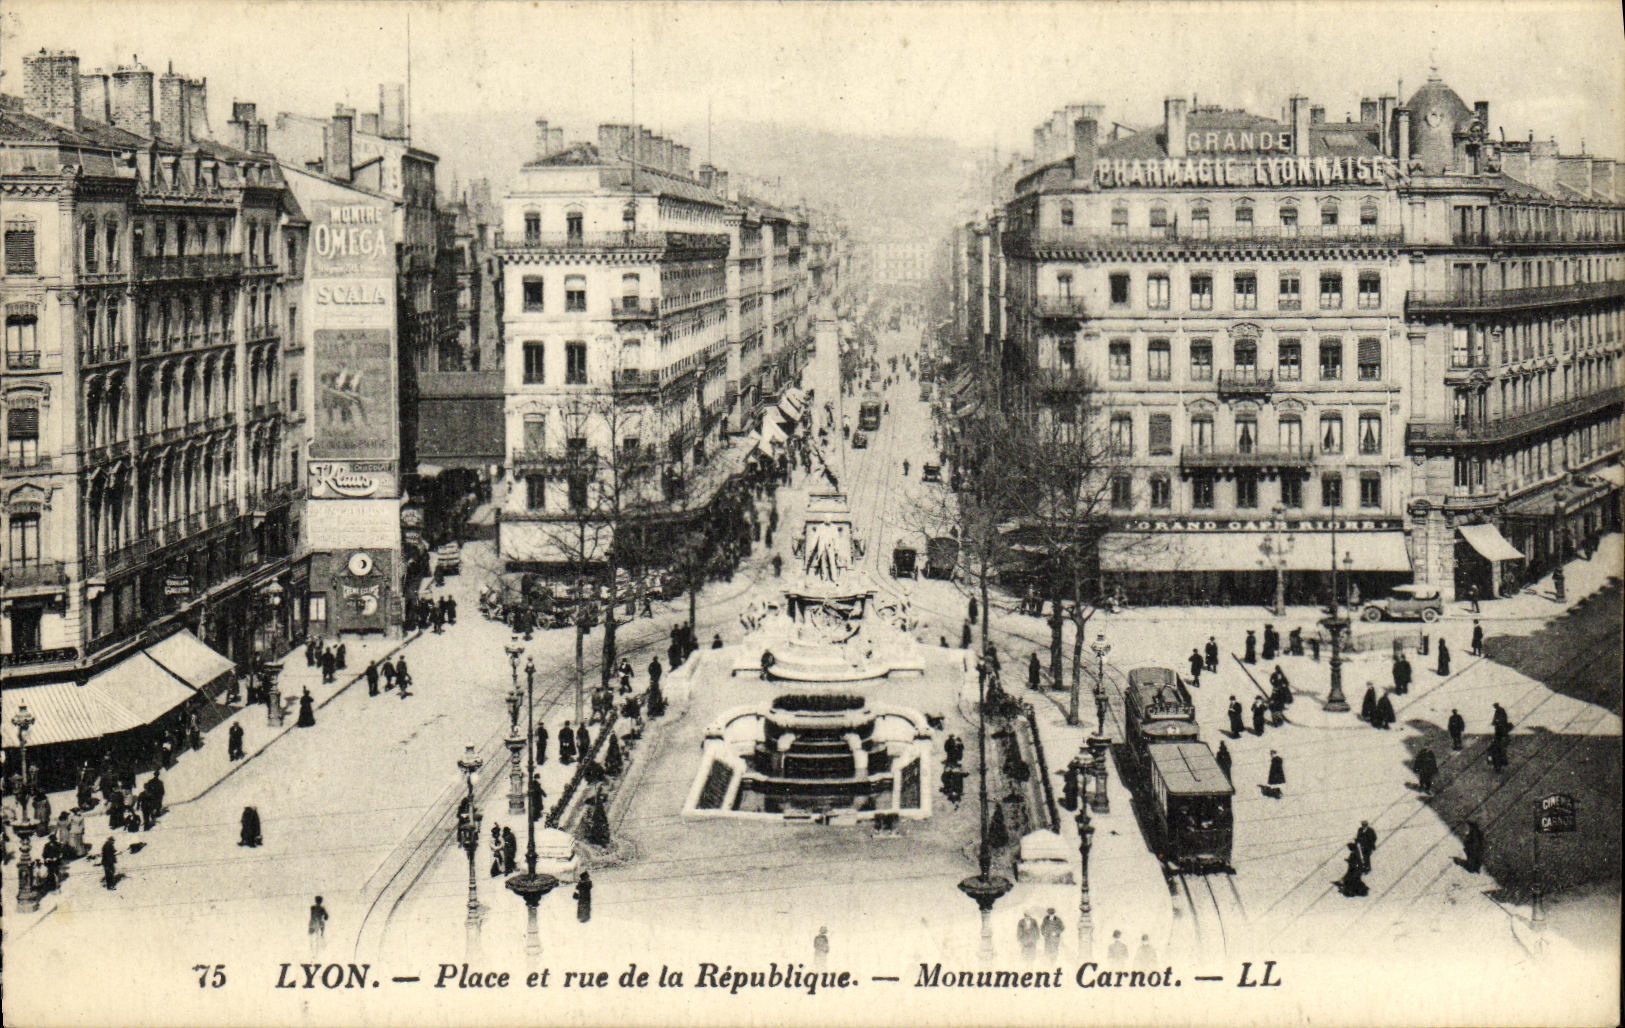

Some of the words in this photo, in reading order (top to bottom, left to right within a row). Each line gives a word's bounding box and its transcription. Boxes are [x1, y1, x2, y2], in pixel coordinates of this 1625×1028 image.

[1187, 131, 1291, 151] GRANDE
[1098, 157, 1238, 187] PHARMACIE
[1254, 154, 1386, 184] LYONNAISE
[330, 206, 383, 224] MONTRE
[315, 224, 387, 260] OMEGA
[316, 284, 386, 306] SCALA
[1138, 521, 1218, 531] GRAND
